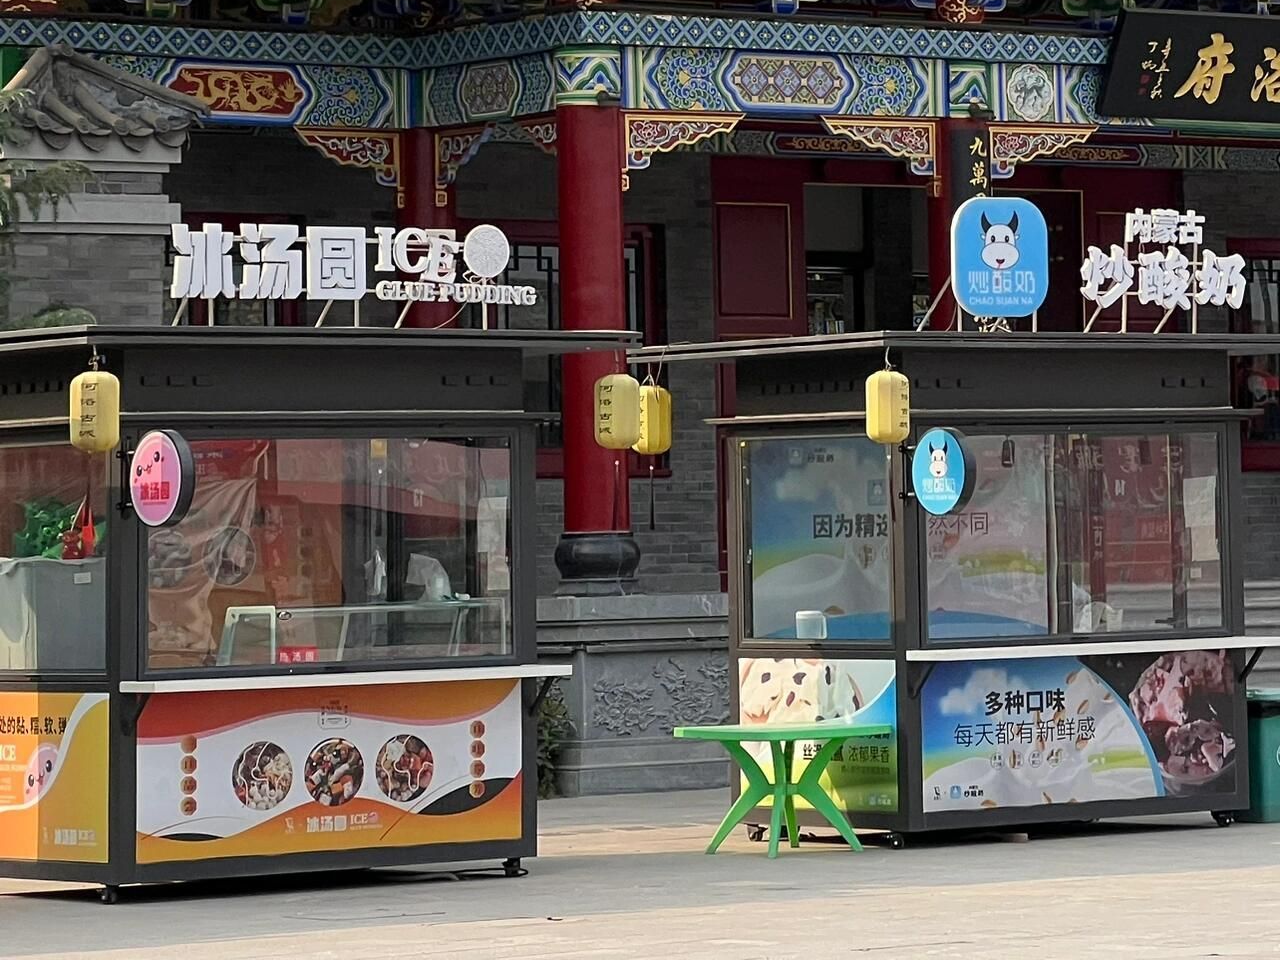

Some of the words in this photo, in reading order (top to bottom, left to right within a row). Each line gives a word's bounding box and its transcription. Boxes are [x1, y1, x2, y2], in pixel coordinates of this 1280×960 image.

[1125, 207, 1206, 245] 内蒙古
[170, 223, 367, 300] 冰汤圆
[374, 226, 460, 283] ICE
[375, 280, 436, 302] GLUE
[437, 283, 538, 306] PUDDING
[968, 270, 1036, 294] 炒酸奶
[1079, 243, 1247, 311] 炒酸奶
[969, 296, 994, 305] CHAO
[995, 296, 1019, 305] SUAN
[984, 688, 1066, 716] 多种口味
[953, 716, 1096, 748] 每天都有新鲜感
